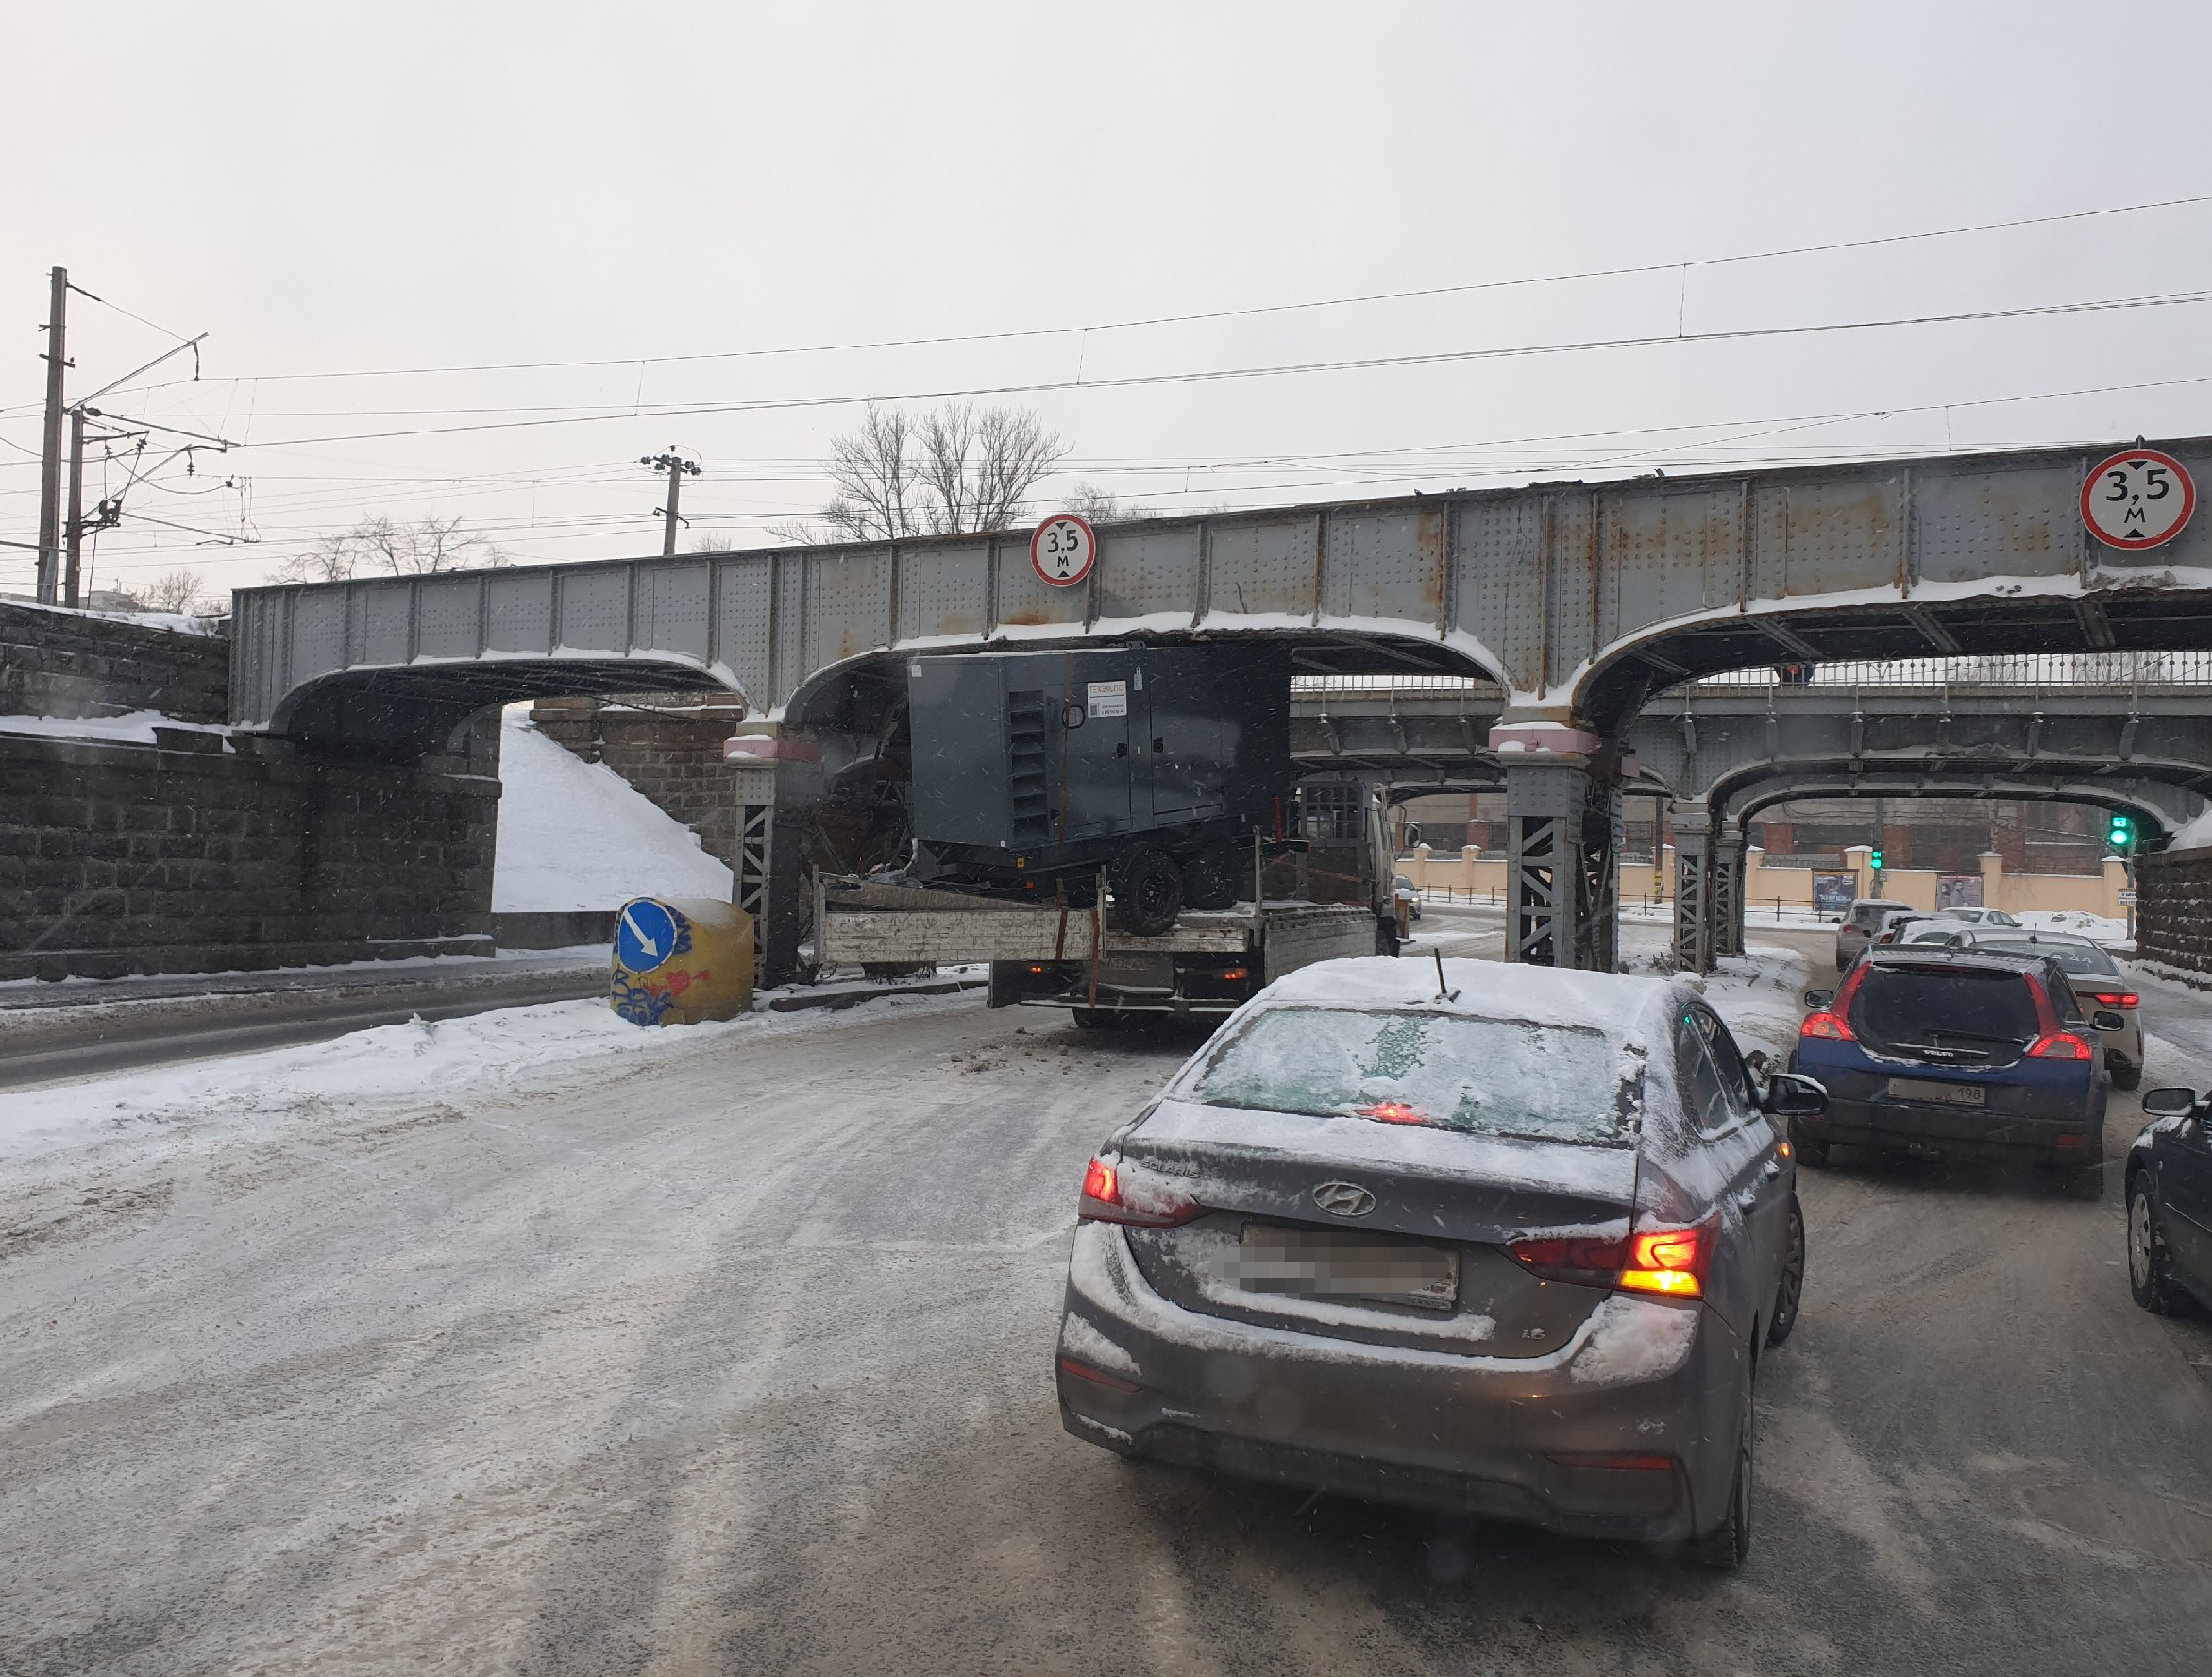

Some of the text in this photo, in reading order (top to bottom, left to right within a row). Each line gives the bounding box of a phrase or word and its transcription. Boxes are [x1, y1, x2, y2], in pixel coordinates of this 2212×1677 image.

[2106, 469, 2170, 505] 3,5
[1047, 529, 1079, 554] 3,5
[1923, 1049, 1954, 1057] VOLVO
[1139, 1160, 1200, 1178] SOLARIS
